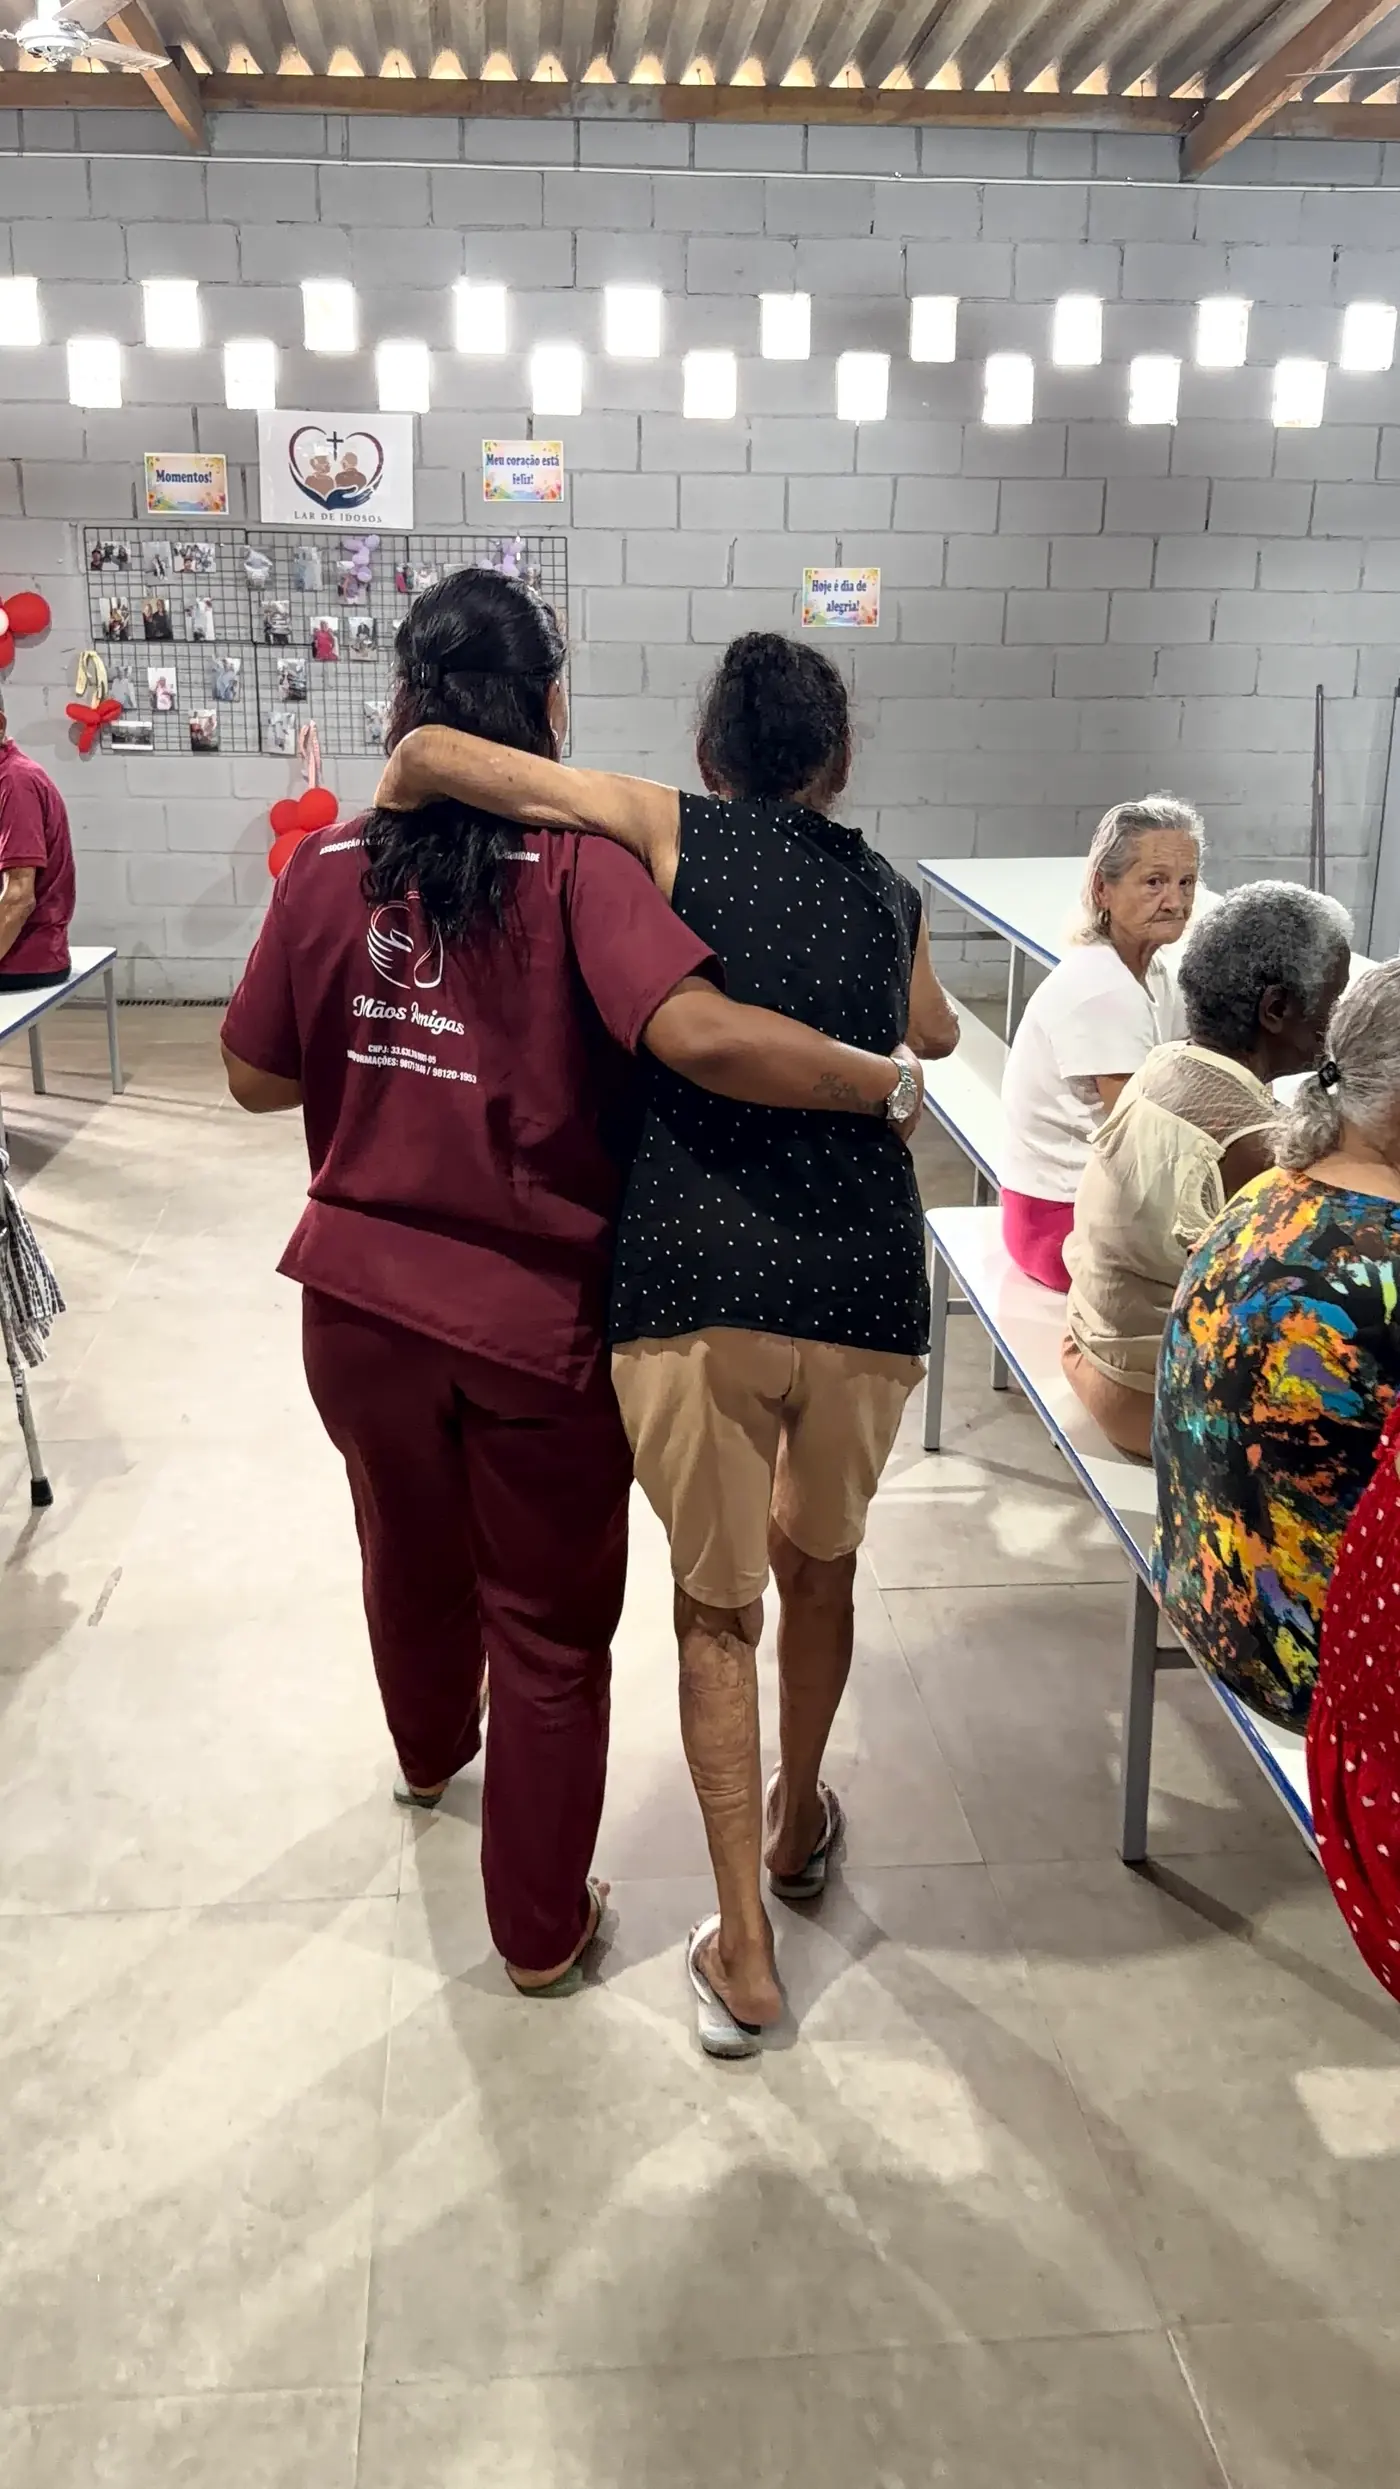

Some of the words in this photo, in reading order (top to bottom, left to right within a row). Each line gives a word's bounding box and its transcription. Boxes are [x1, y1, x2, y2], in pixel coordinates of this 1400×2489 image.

[486, 453, 504, 466] Meu
[506, 454, 540, 468] coração
[542, 454, 560, 466] está
[156, 469, 213, 483] Momentos!
[512, 473, 534, 485] feliz!
[294, 510, 315, 520] LAR
[321, 513, 335, 521] DE
[340, 513, 382, 523] IDOSOS
[812, 580, 832, 595] Hoje
[834, 579, 839, 592] é
[841, 580, 854, 592] dia
[856, 580, 867, 592] de
[826, 600, 860, 615] alegria!
[352, 995, 407, 1020] Mãos
[411, 1001, 465, 1035] Amigas
